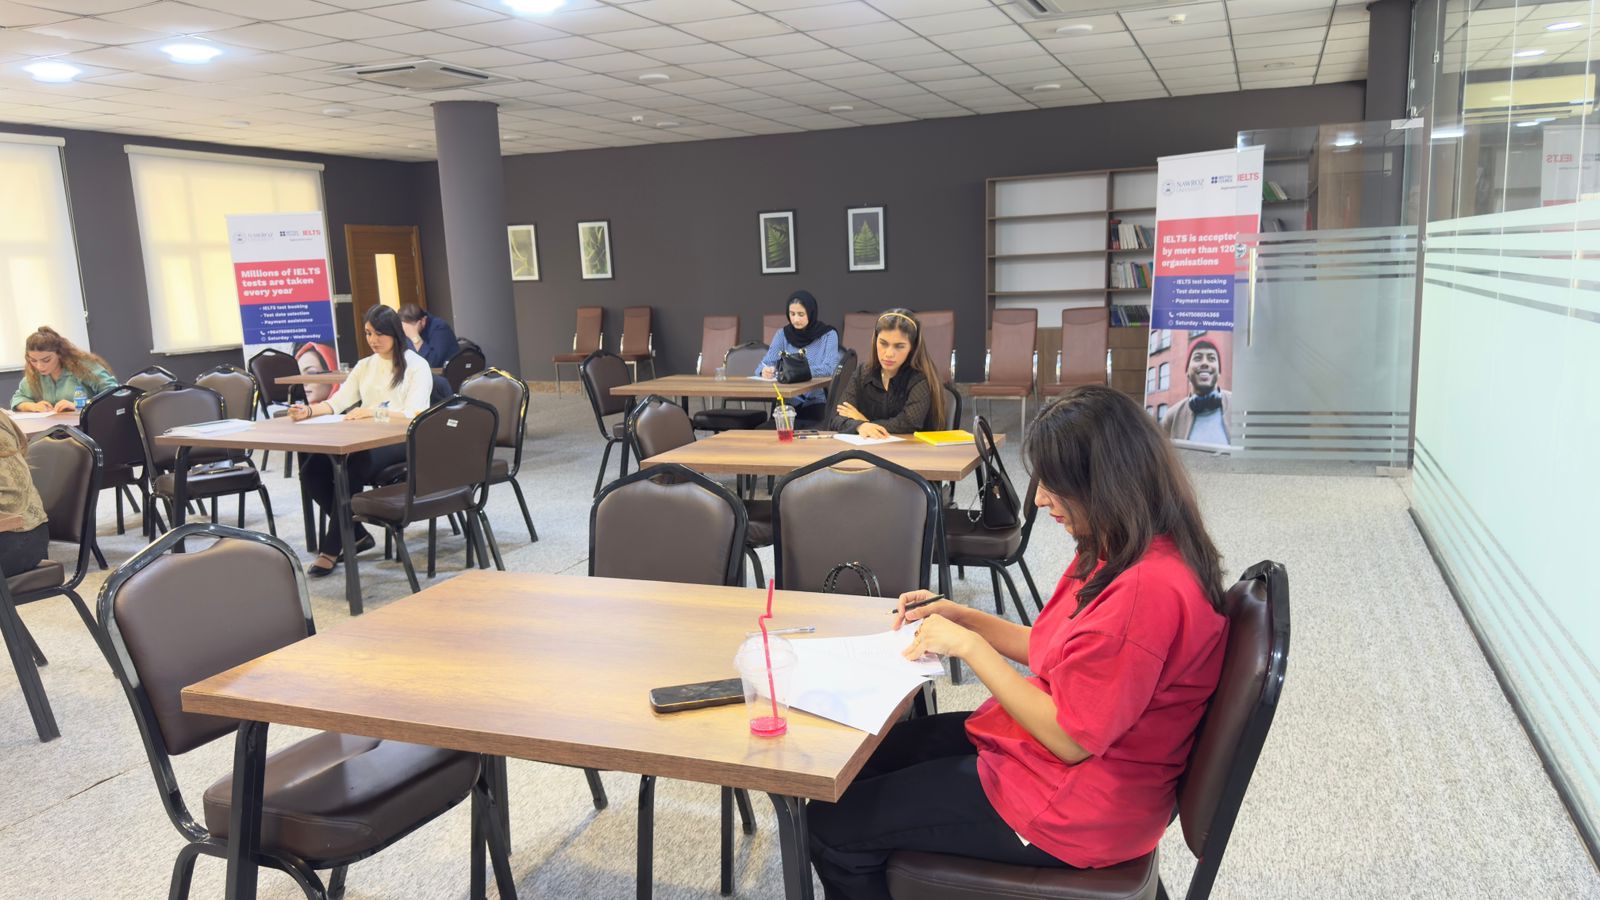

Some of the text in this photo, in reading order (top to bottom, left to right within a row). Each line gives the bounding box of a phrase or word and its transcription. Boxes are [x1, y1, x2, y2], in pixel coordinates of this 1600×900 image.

[1237, 172, 1260, 182] IELTS
[1163, 234, 1188, 243] IELTS
[1189, 234, 1196, 242] is
[1162, 247, 1173, 257] by
[1174, 247, 1196, 255] more
[1198, 245, 1218, 254] than
[1162, 258, 1219, 269] organisations
[241, 267, 321, 278] Millions of IELTS
[242, 279, 267, 287] tests
[287, 277, 314, 285] taken
[243, 288, 293, 297] every year
